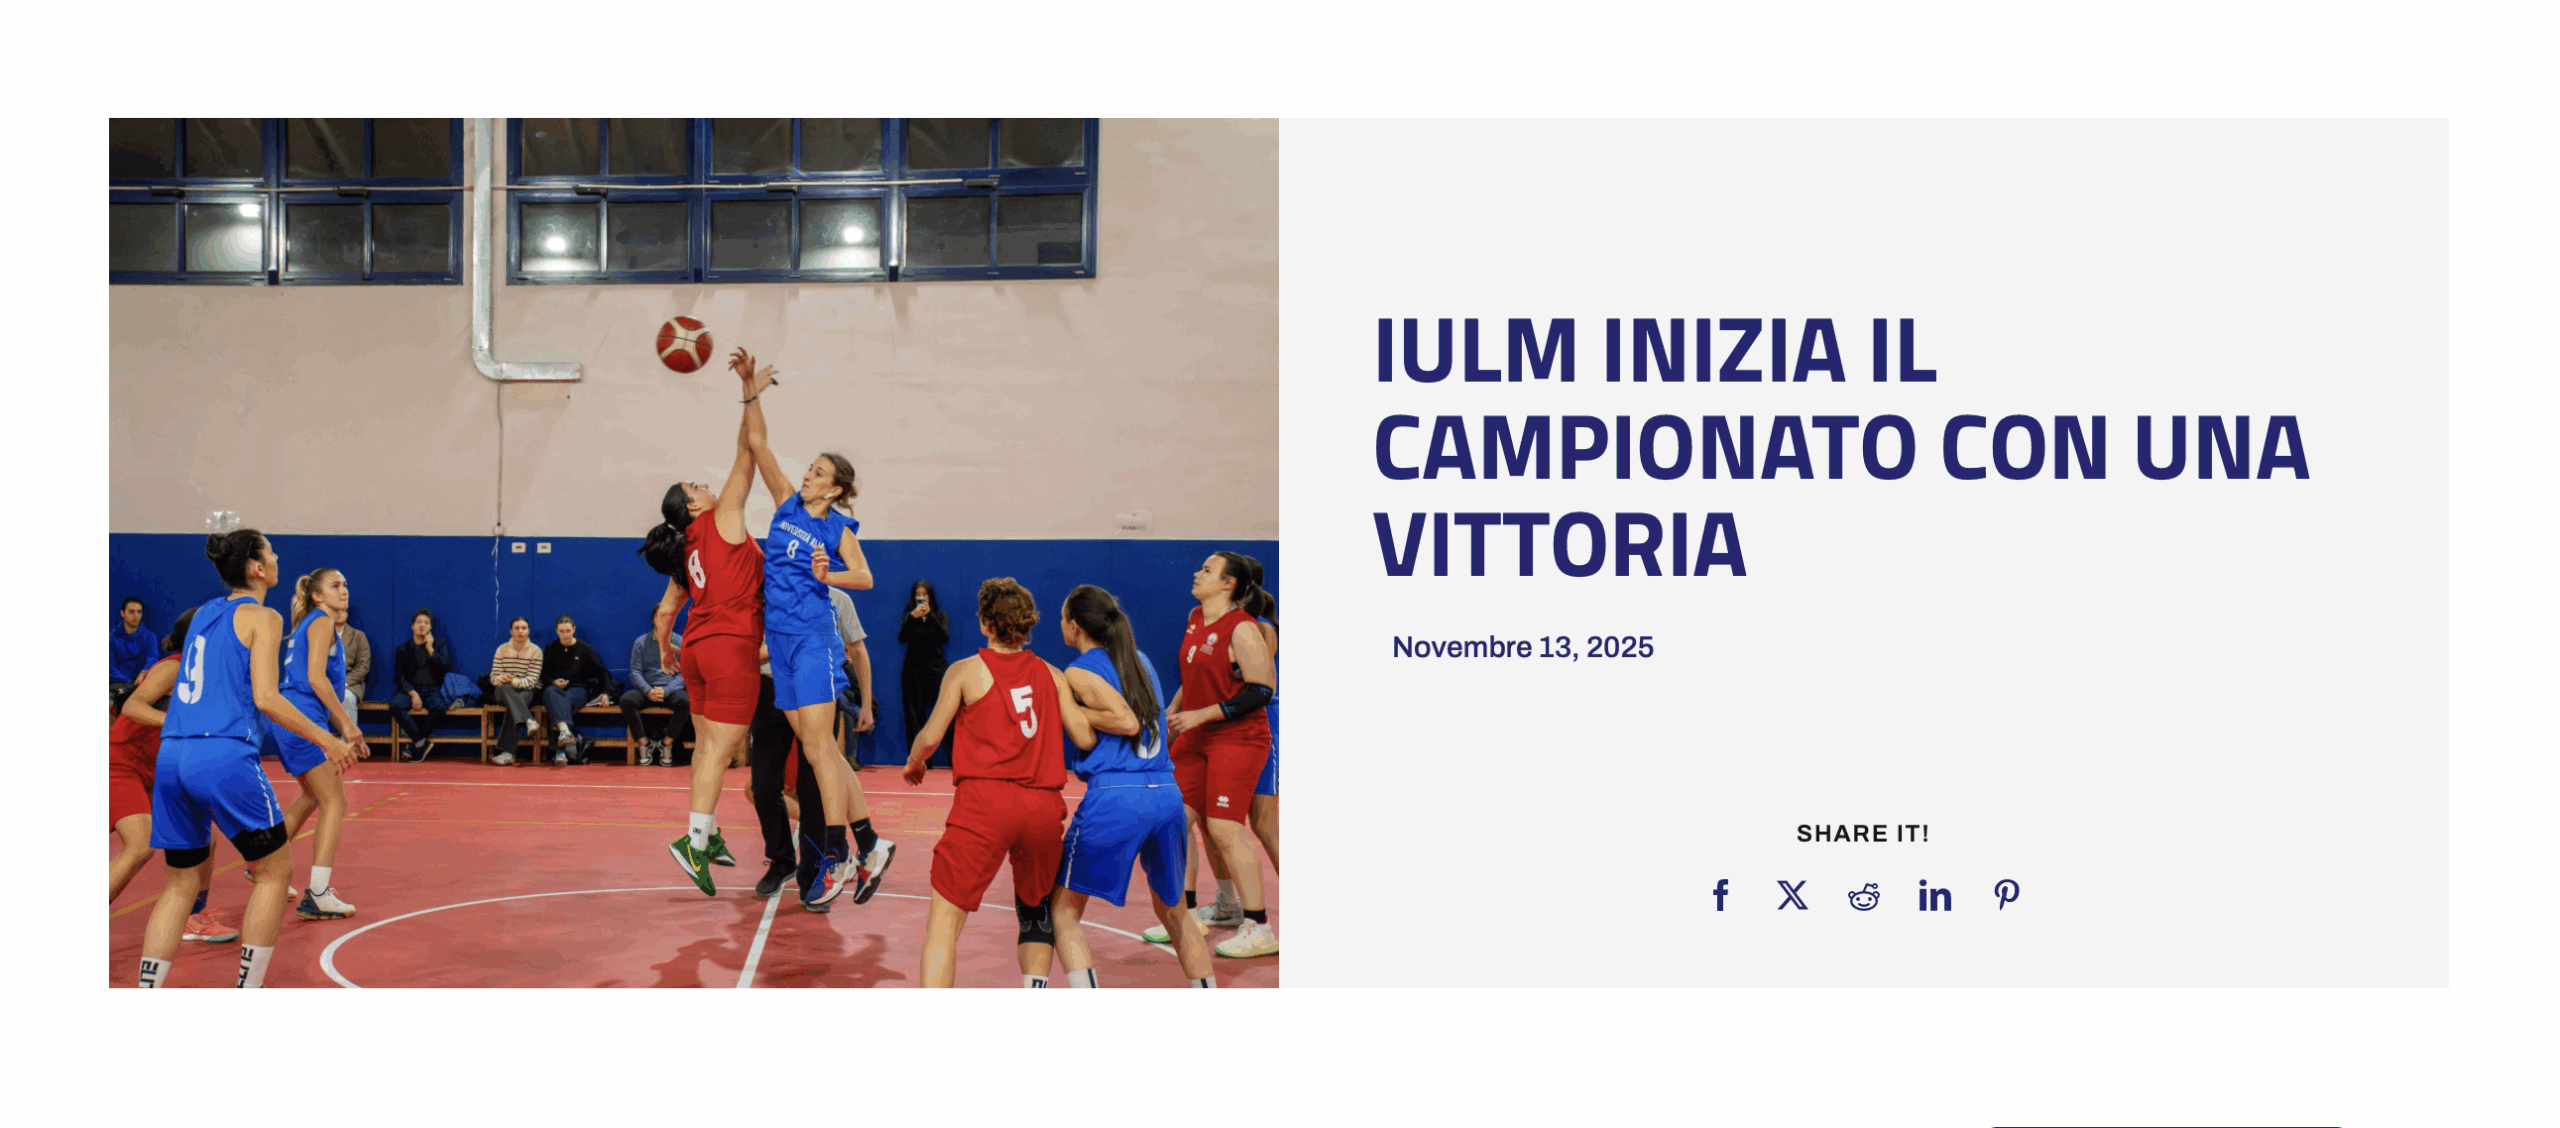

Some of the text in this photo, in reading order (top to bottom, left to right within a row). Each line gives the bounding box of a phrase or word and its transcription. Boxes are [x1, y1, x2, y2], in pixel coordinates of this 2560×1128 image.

[688, 549, 706, 589] 8
[786, 539, 800, 559] 8
[177, 634, 206, 705] 9
[1187, 645, 1197, 663] 9
[1010, 685, 1038, 739] 5
